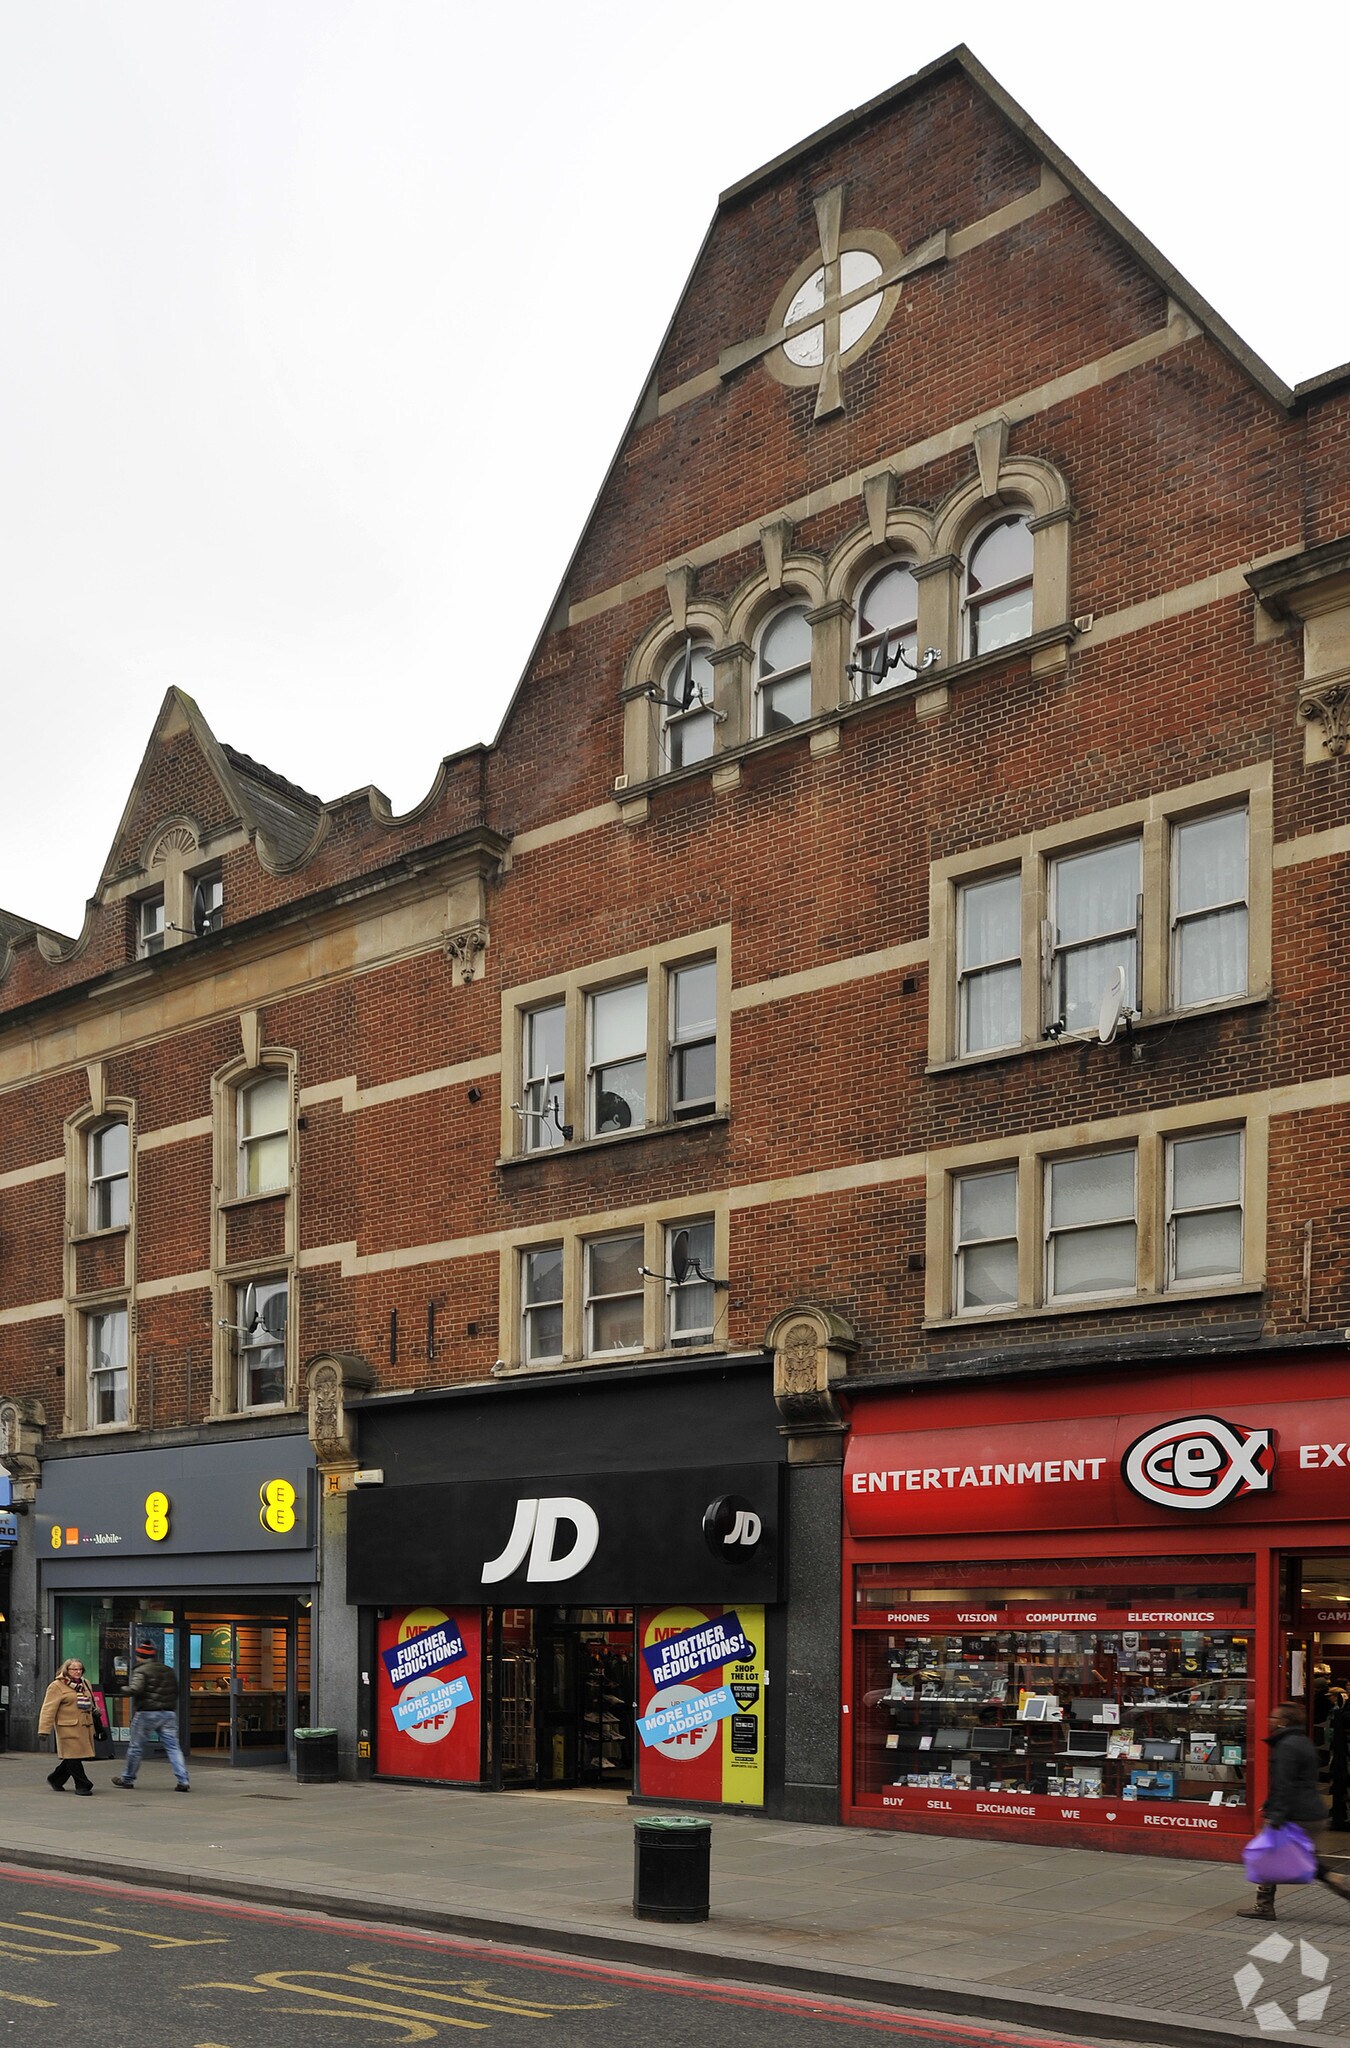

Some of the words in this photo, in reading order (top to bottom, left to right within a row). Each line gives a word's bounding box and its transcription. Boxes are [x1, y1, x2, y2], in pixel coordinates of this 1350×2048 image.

[1300, 1443, 1350, 1469] EX
[852, 1457, 1107, 1494] ENTERTAINMENT
[481, 1496, 600, 1583] JD
[723, 1510, 762, 1546] JD
[887, 1613, 930, 1623] PHONES
[957, 1613, 998, 1623] VISION
[1025, 1613, 1098, 1623] COMPUTING
[1127, 1612, 1215, 1623] ELECTRONICS
[390, 1638, 463, 1683] REDUCTIONS!
[397, 1630, 447, 1665] FURTHER
[652, 1633, 746, 1684] REDUCTIONS!
[661, 1624, 725, 1664] FURTHER
[735, 1665, 755, 1673] SHOP
[746, 1673, 759, 1681] LOT
[398, 1695, 429, 1717] MORE
[432, 1680, 464, 1701] LINES
[416, 1698, 452, 1721] ADDED
[645, 1708, 684, 1731] MORE
[686, 1690, 727, 1713] LINES
[667, 1709, 713, 1736] ADDED
[883, 1797, 904, 1807] BUY
[926, 1799, 952, 1810] SELL
[976, 1803, 1036, 1816] EXCHANGE
[1061, 1809, 1081, 1820] WE
[1144, 1814, 1218, 1829] RECYCLING
